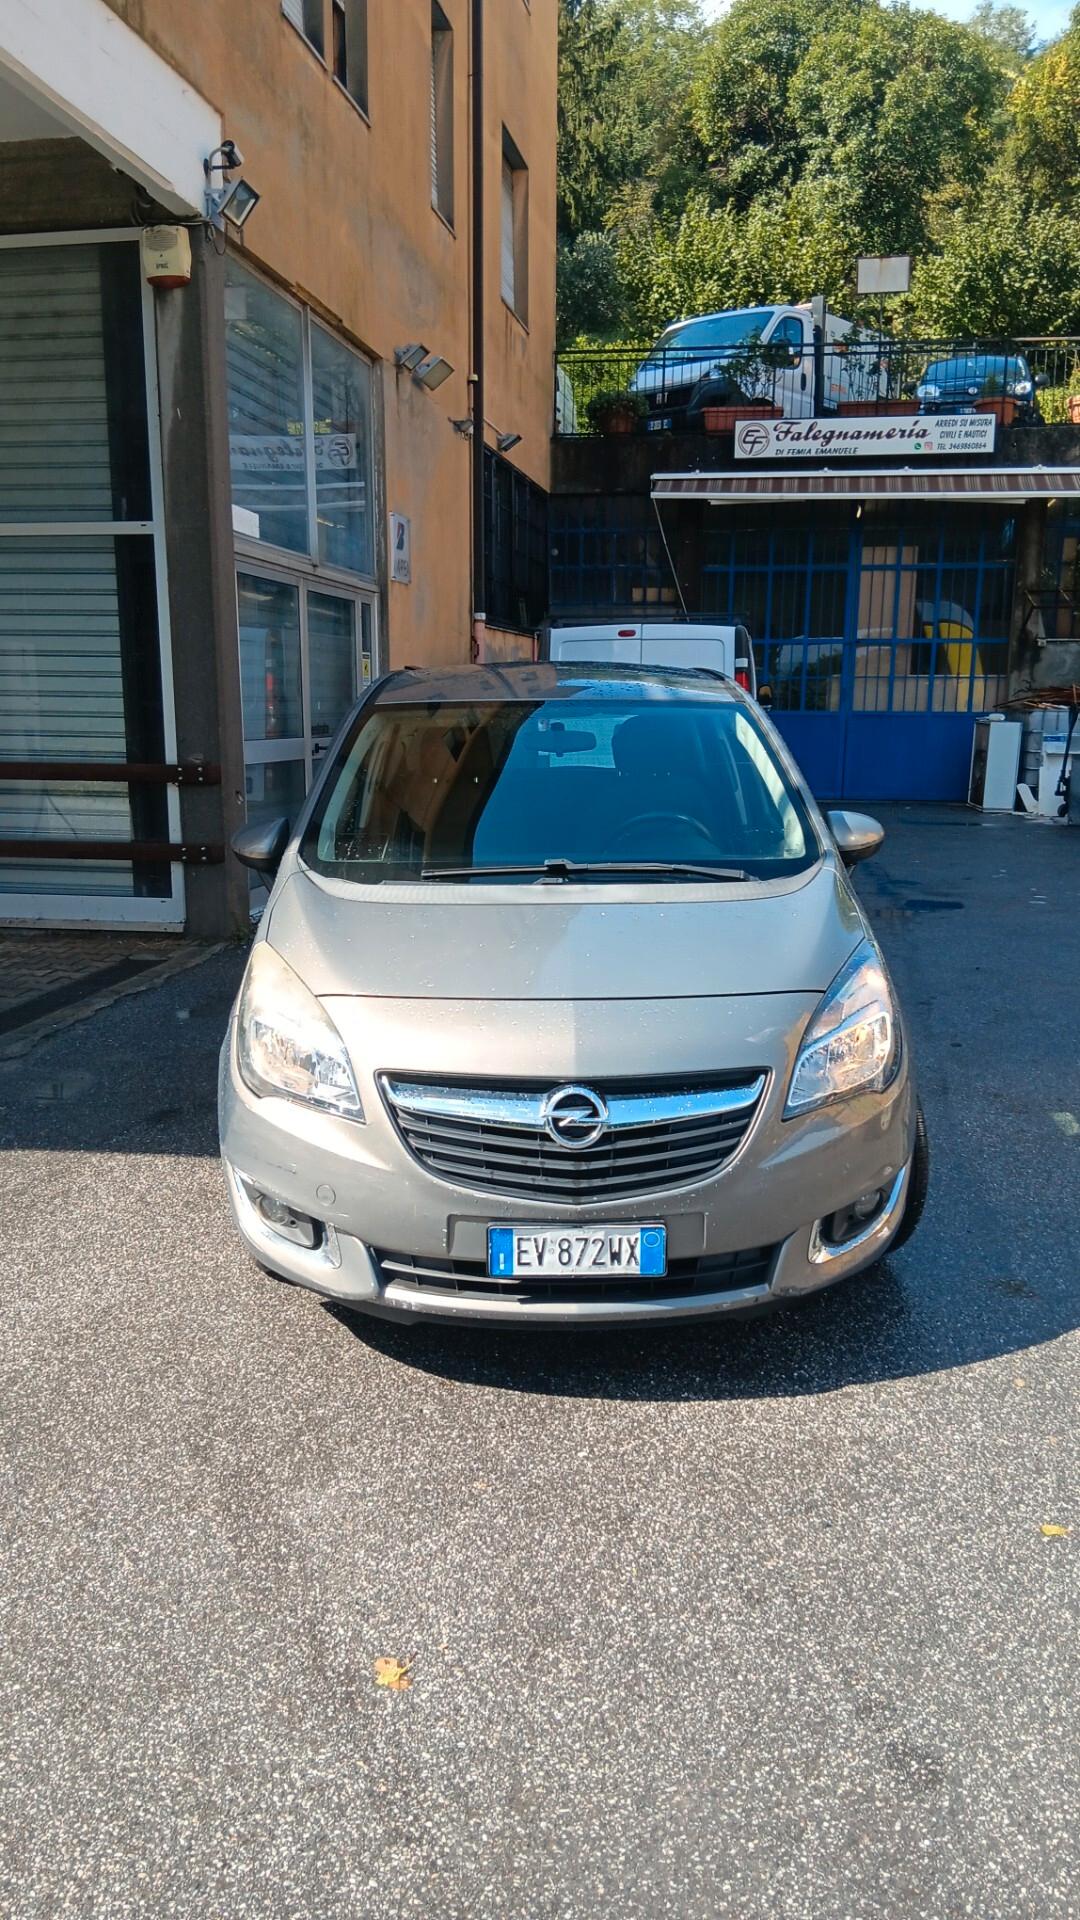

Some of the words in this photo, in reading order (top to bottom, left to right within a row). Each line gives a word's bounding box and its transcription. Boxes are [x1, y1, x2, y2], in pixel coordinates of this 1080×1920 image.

[935, 419, 957, 428] ARREDI
[959, 418, 968, 427] SU
[969, 418, 992, 427] MISURA
[773, 419, 931, 448] Falegnameria
[940, 430, 957, 439] CIVILI
[958, 430, 963, 438] E
[964, 430, 987, 438] NAUTICI
[775, 448, 784, 456] DI
[786, 448, 812, 456] FEMIA
[814, 447, 858, 455] EMANUELE
[517, 1237, 547, 1267] EV
[557, 1236, 641, 1267] 872WX
